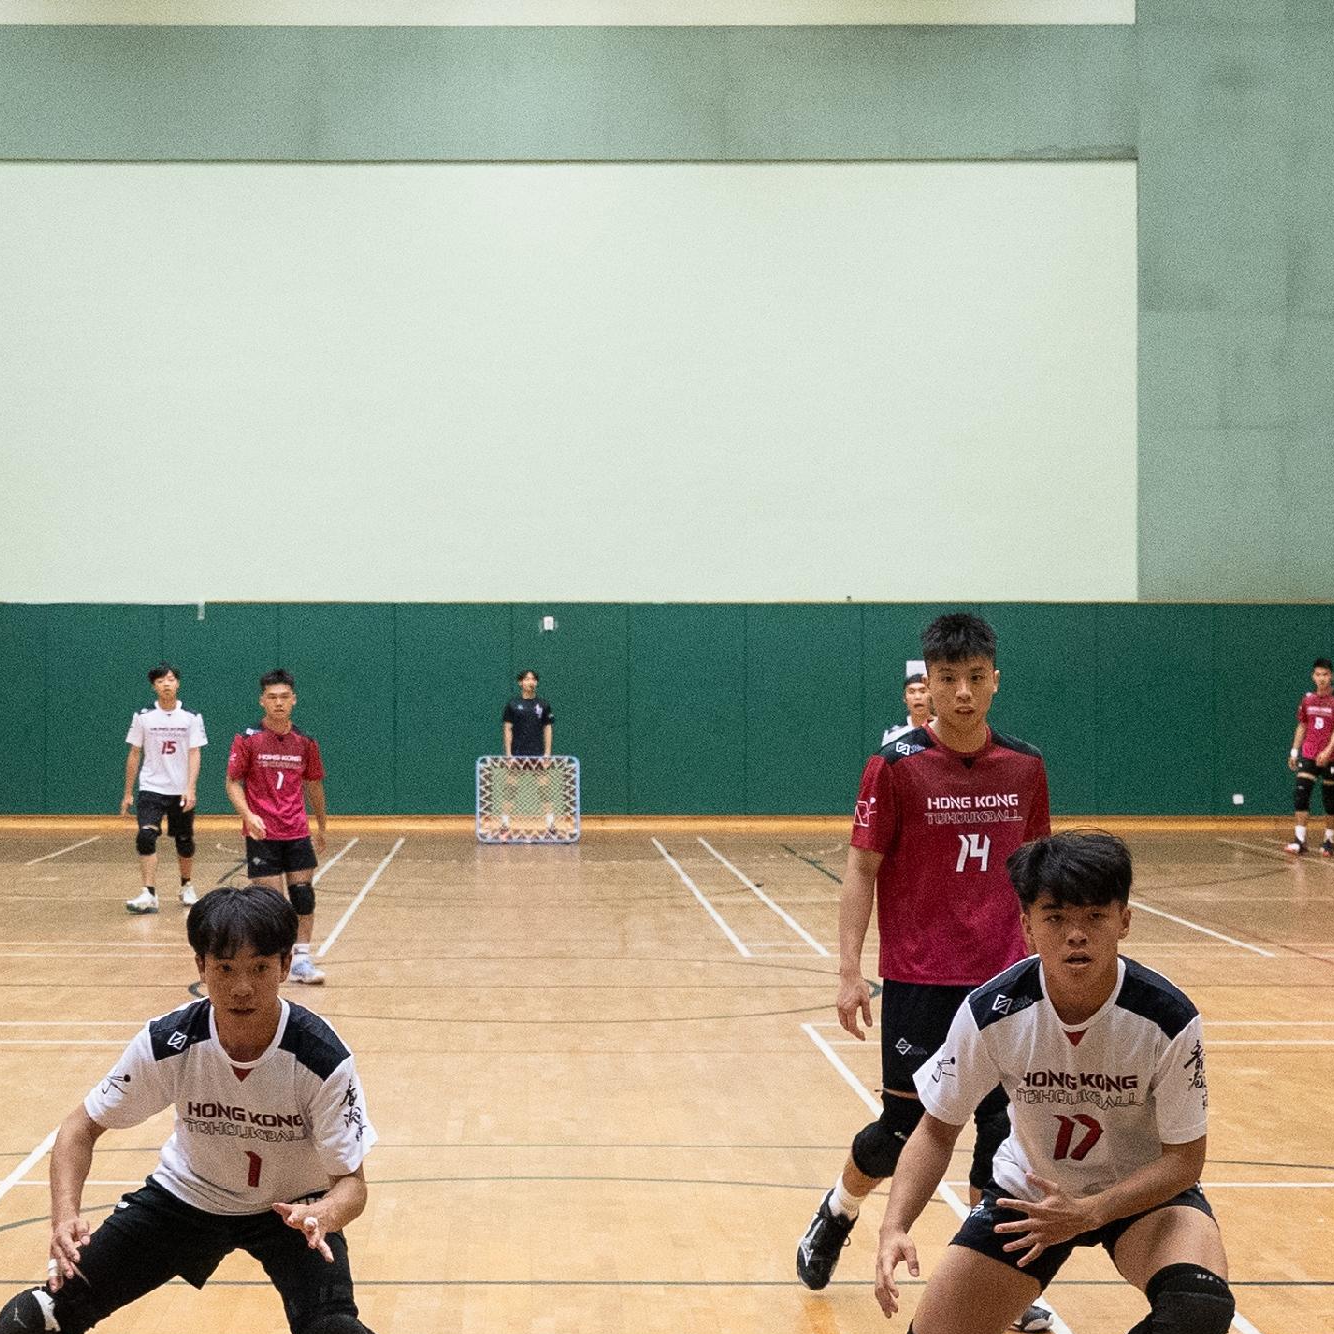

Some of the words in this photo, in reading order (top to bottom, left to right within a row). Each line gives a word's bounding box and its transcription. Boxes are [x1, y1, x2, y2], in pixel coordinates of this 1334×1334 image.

[161, 740, 177, 755] 15
[276, 771, 284, 790] 1
[927, 794, 972, 810] HONG
[974, 792, 1019, 809] KONG
[955, 833, 992, 873] 14
[1022, 1068, 1078, 1090] HONG
[1079, 1072, 1139, 1093] KONG
[187, 1101, 247, 1123] HONG
[247, 1110, 305, 1129] KONG
[1053, 1113, 1104, 1162] 17
[244, 1150, 263, 1188] 1
